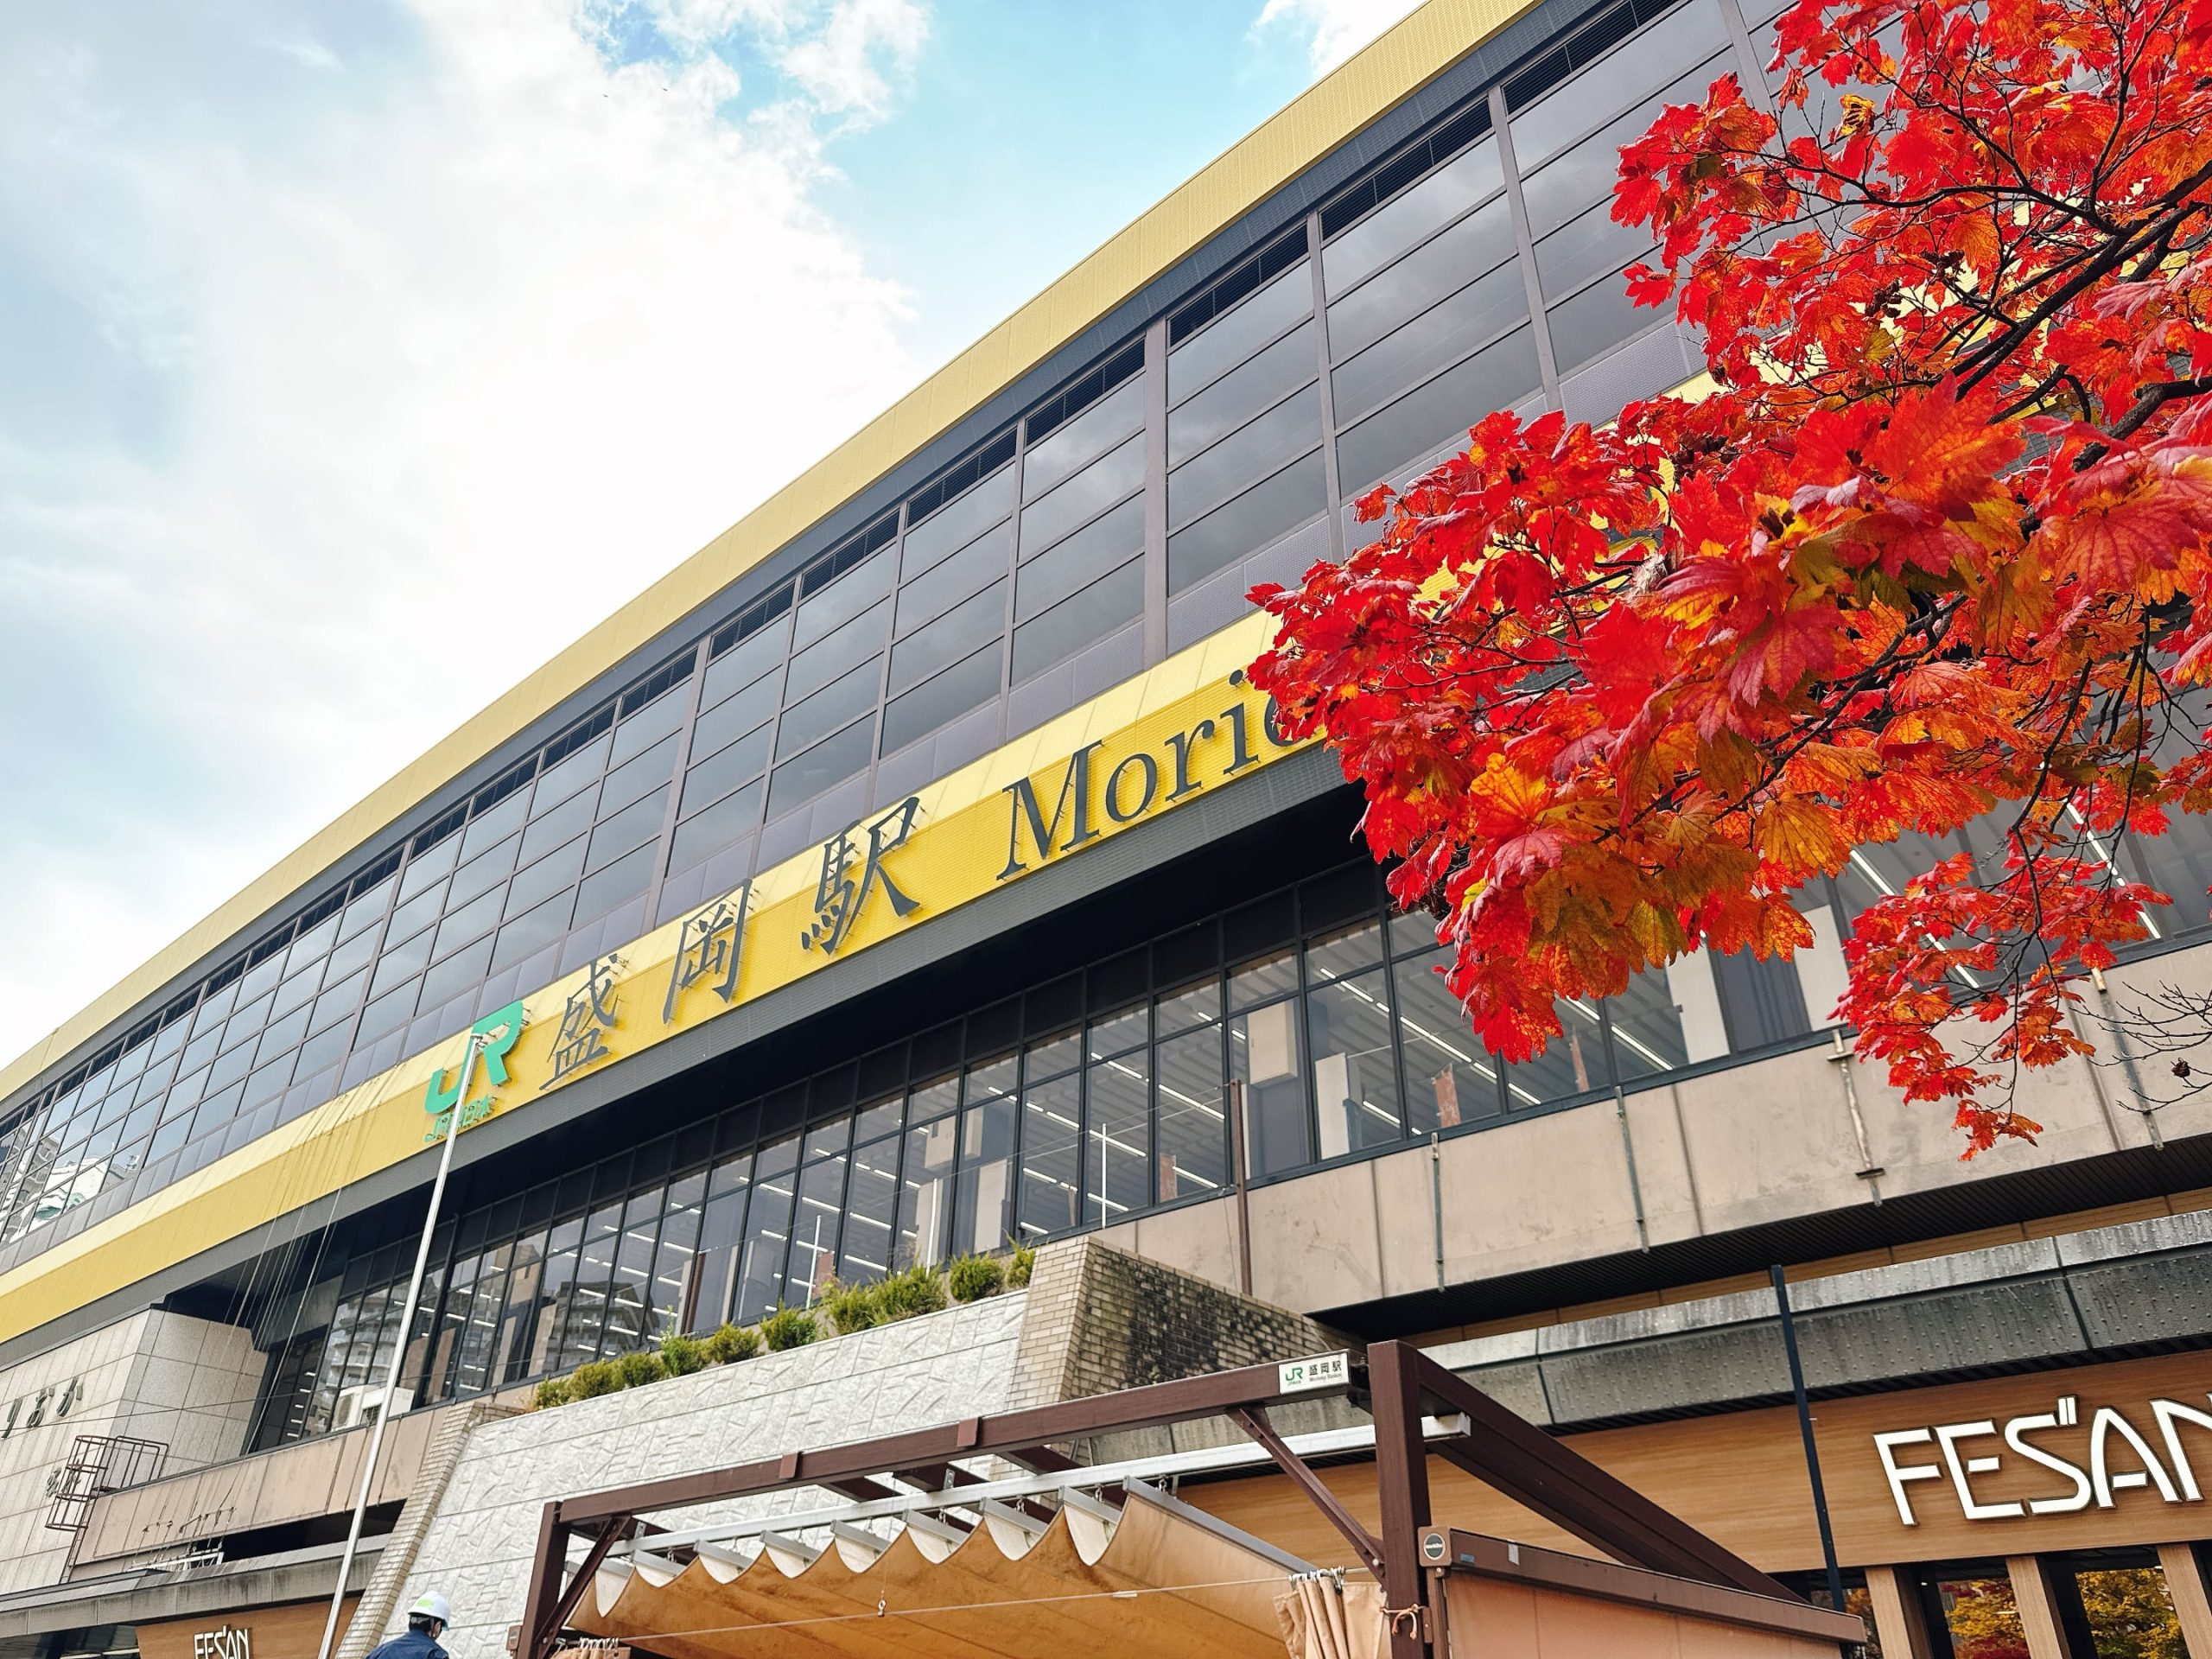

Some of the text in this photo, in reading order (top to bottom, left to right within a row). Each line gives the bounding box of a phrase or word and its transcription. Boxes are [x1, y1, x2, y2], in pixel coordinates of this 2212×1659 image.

[424, 999, 524, 1115] JR
[539, 797, 921, 1090] 盛岡駅
[1285, 1366, 1303, 1382] JR
[1309, 1360, 1342, 1376] 盛岡駅
